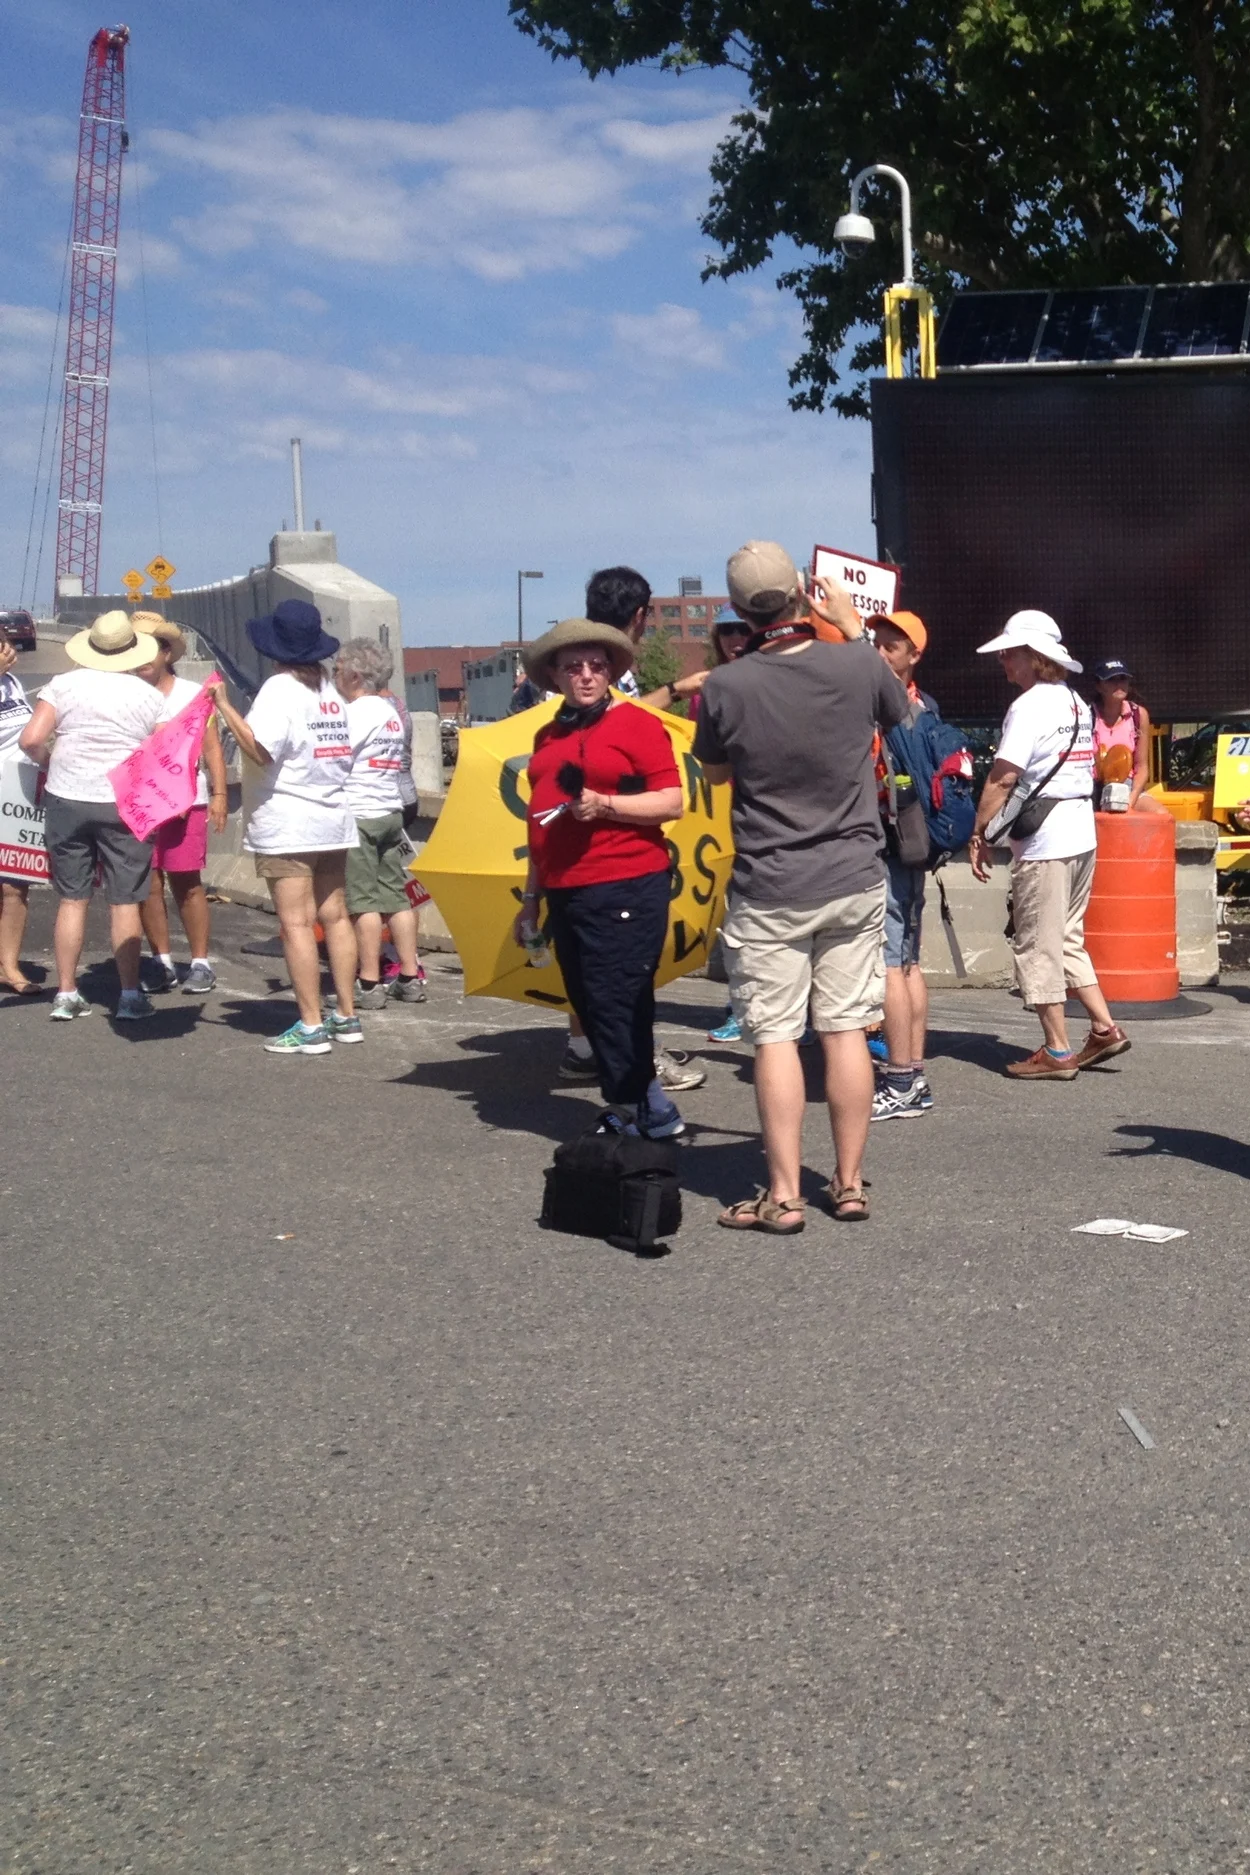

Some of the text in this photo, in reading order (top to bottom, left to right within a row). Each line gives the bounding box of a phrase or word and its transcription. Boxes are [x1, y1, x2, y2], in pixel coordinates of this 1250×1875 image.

[843, 566, 867, 586] NO
[319, 701, 340, 715] NO
[385, 720, 400, 732] NO
